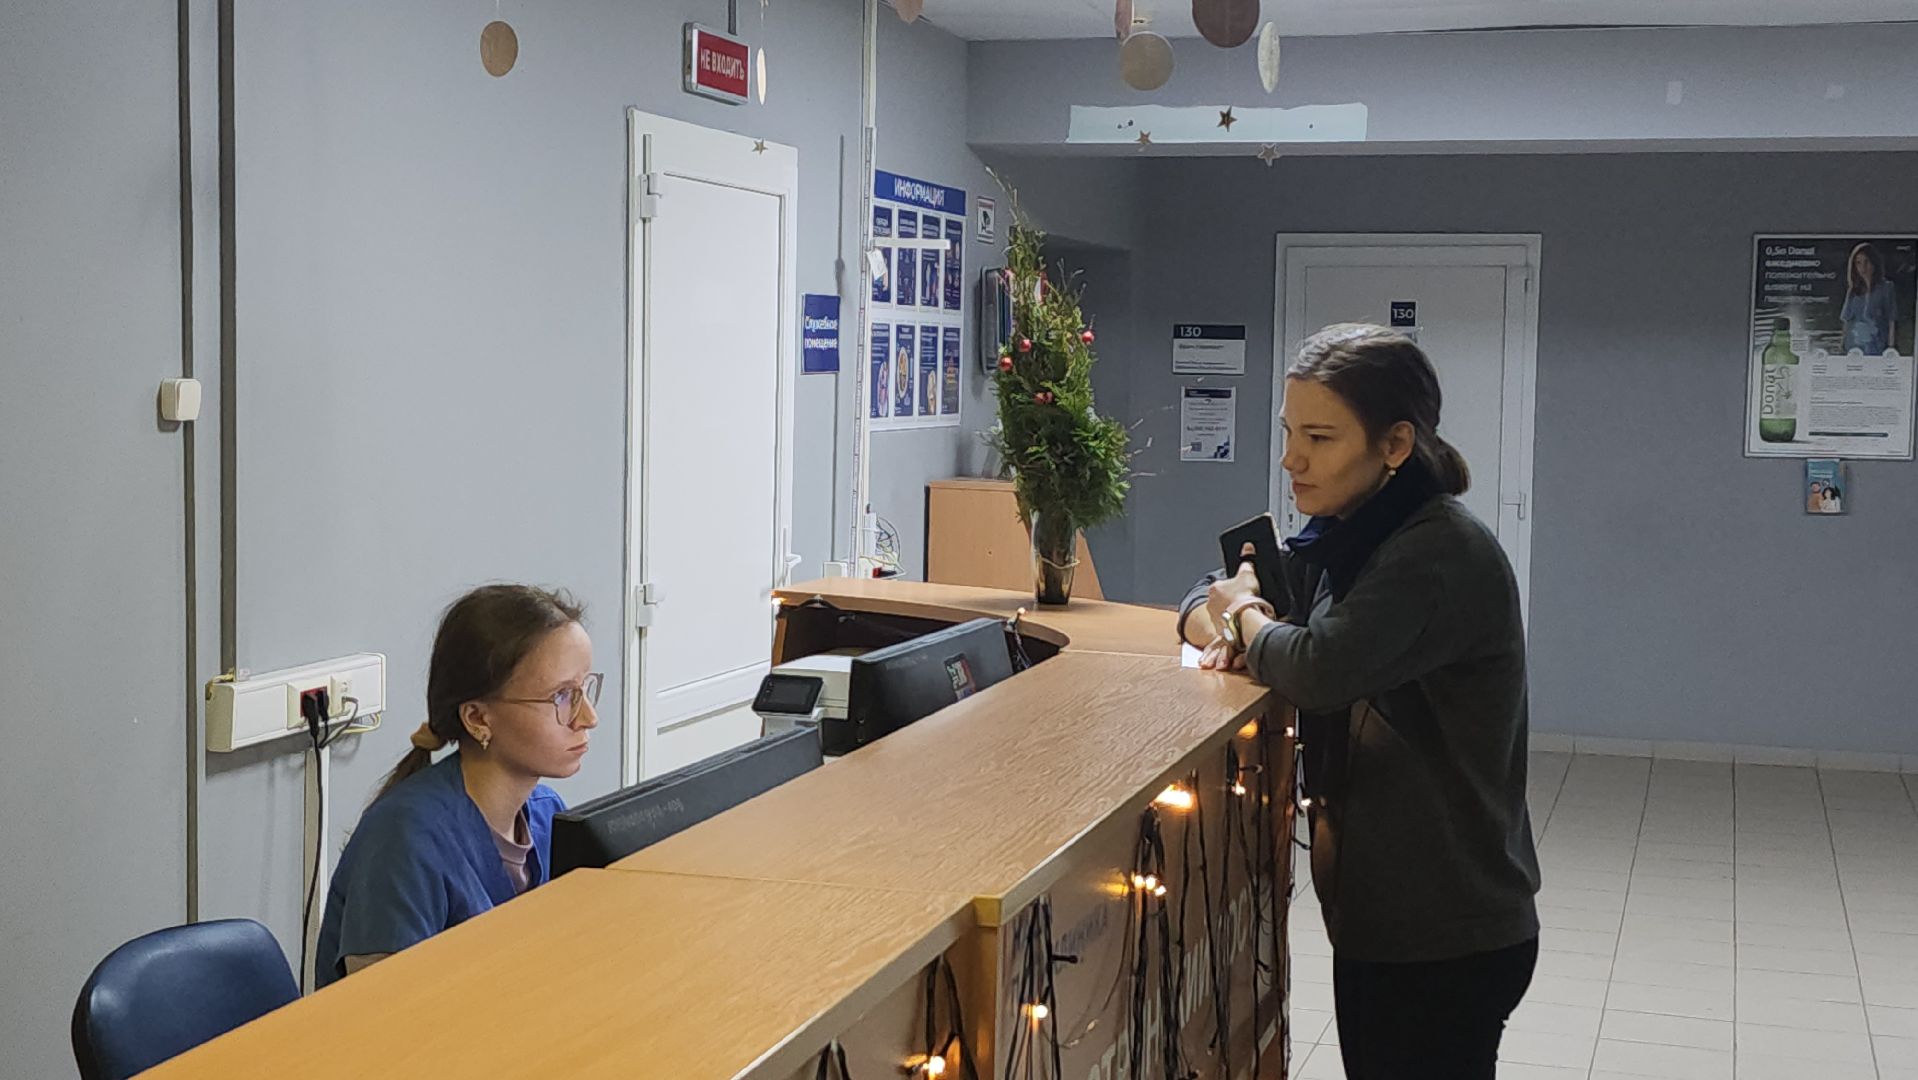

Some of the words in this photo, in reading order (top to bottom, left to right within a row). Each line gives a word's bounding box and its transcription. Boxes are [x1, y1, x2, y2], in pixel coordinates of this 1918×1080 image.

[700, 47, 711, 71] НЕ
[711, 51, 745, 81] ВХОДИТЬ
[894, 176, 945, 208] ИНФОРМАЦИЯ
[1391, 308, 1415, 319] 130
[805, 315, 838, 332] Служебное
[1180, 326, 1202, 337] 130
[804, 337, 838, 350] помещение
[1762, 367, 1776, 415] Donat
